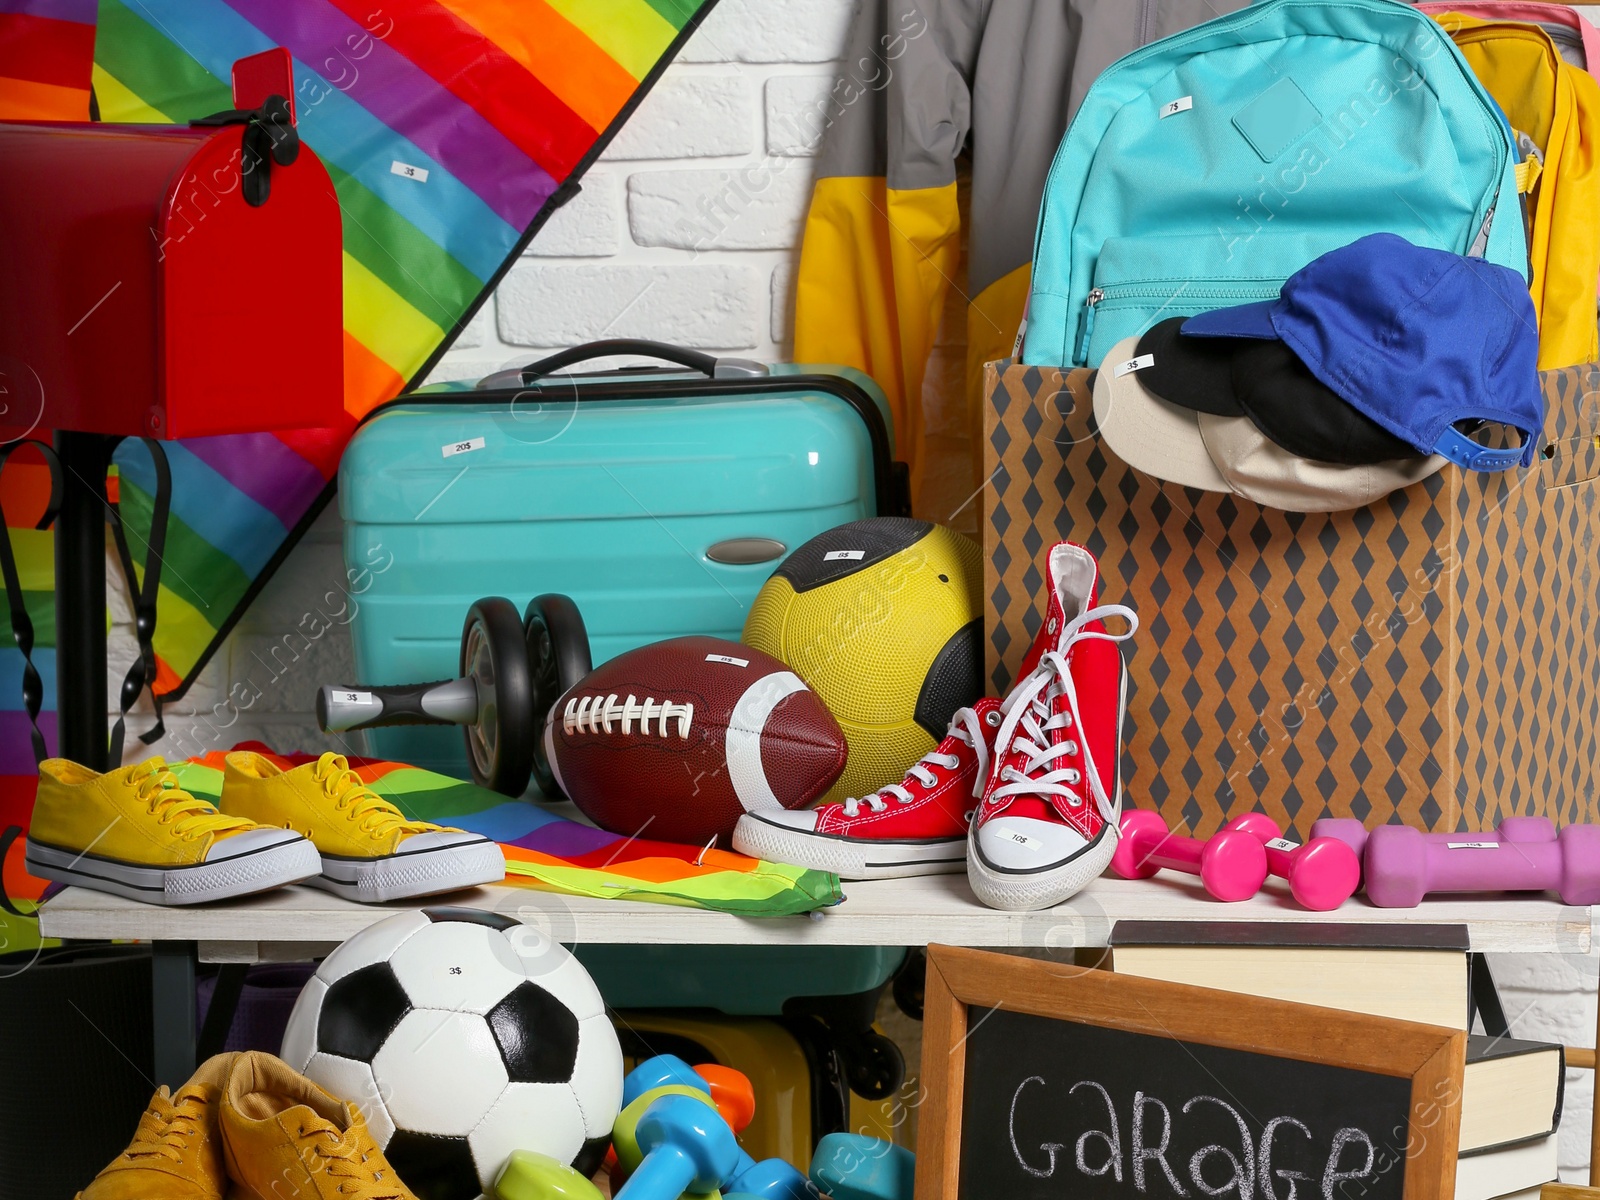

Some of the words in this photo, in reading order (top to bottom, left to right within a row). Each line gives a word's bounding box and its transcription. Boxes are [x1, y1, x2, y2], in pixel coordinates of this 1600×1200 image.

[1169, 100, 1179, 112] 7$
[404, 167, 414, 176] 3$
[1127, 360, 1139, 371] 3$
[455, 441, 472, 453] 20$
[346, 692, 358, 703] 3$
[1011, 833, 1028, 845] 10$
[449, 967, 462, 976] 3$
